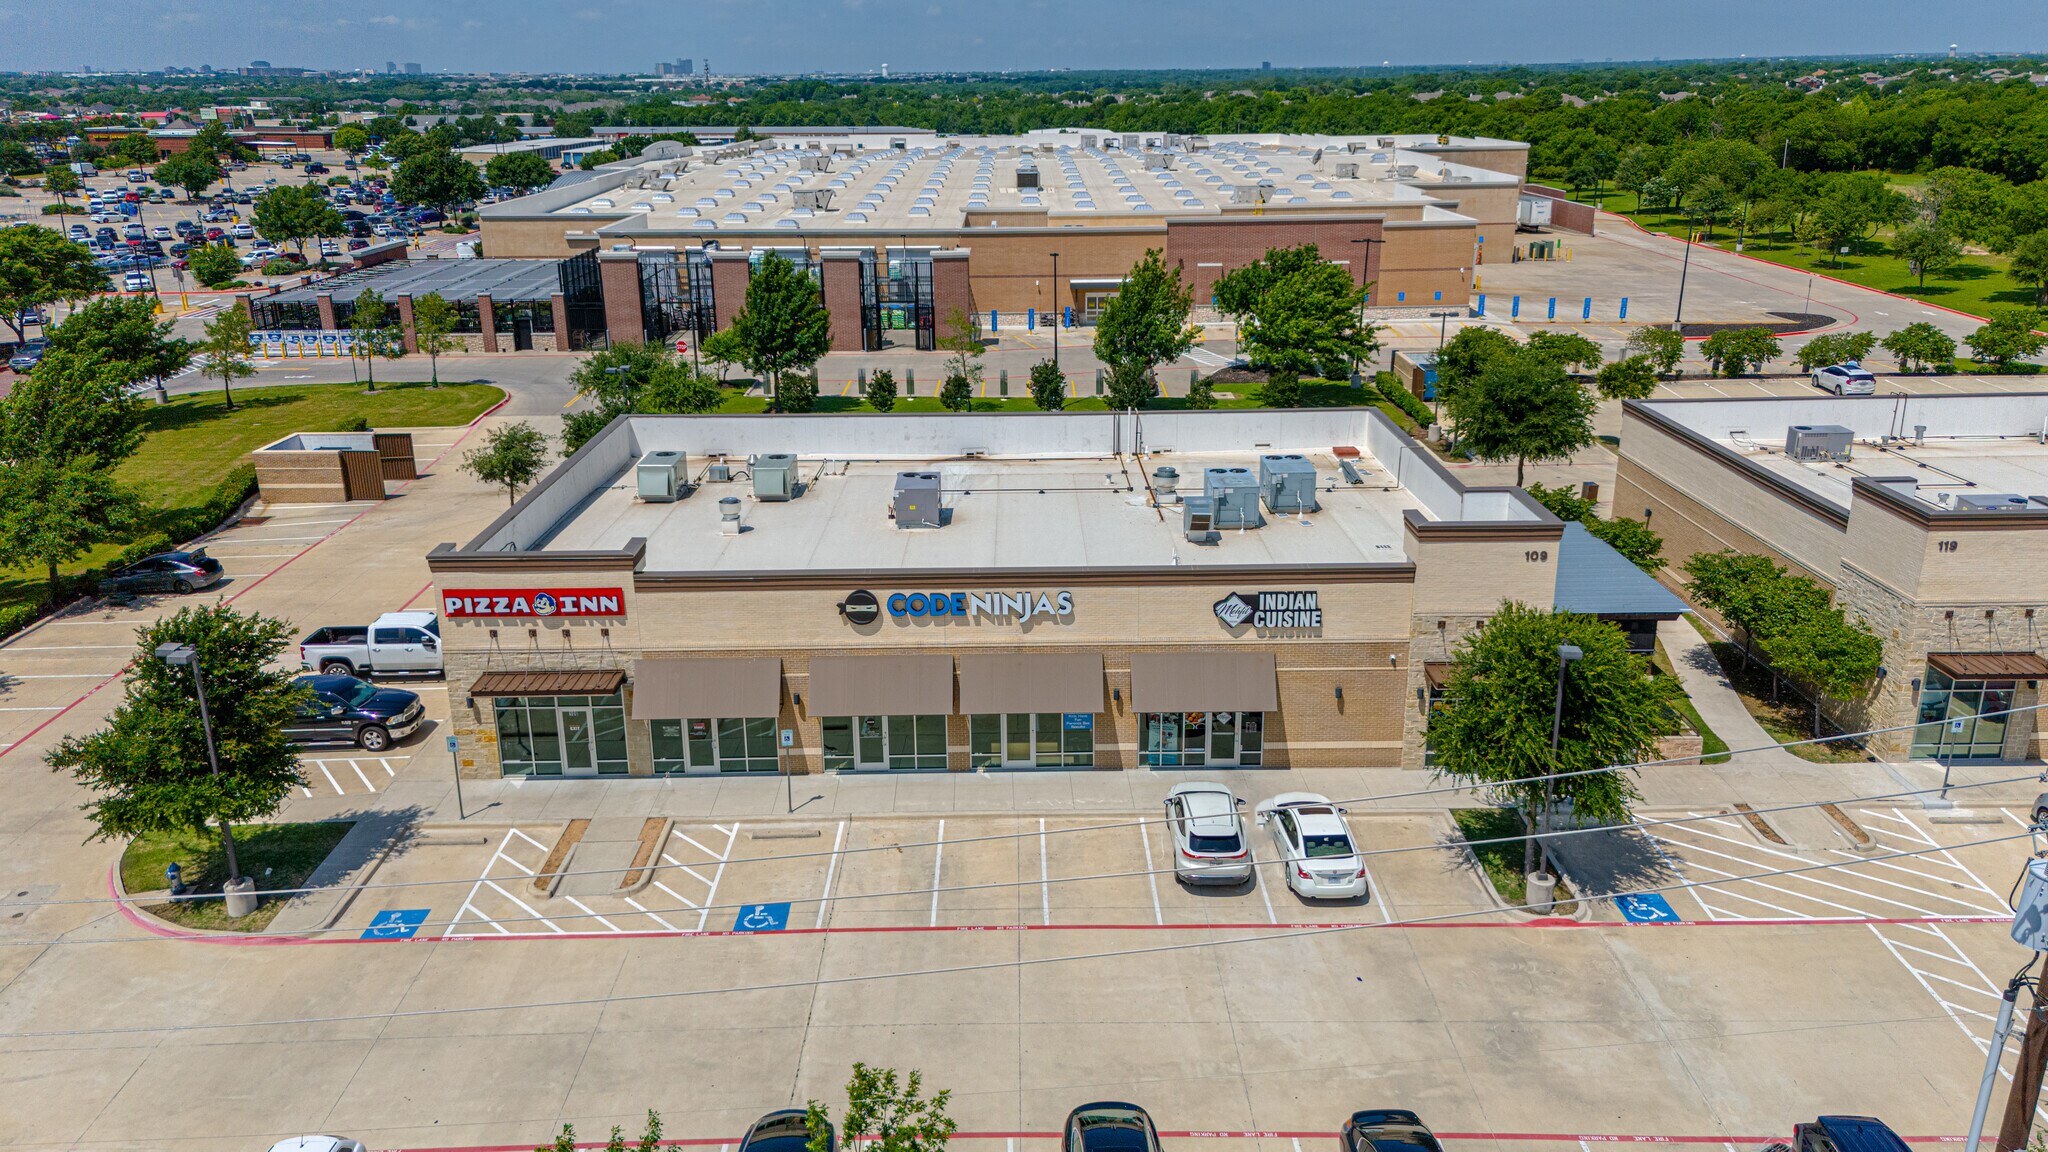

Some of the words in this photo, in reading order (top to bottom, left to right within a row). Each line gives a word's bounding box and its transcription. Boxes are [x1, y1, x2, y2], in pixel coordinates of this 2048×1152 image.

[1938, 541, 1957, 553] 119
[1525, 551, 1548, 562] 109
[445, 596, 531, 614] PIZZA
[560, 596, 619, 613] INN
[887, 592, 966, 616] CODE
[970, 591, 1072, 623] NINJAS
[1259, 592, 1317, 610] INDIAN
[1253, 611, 1321, 628] CUISINE
